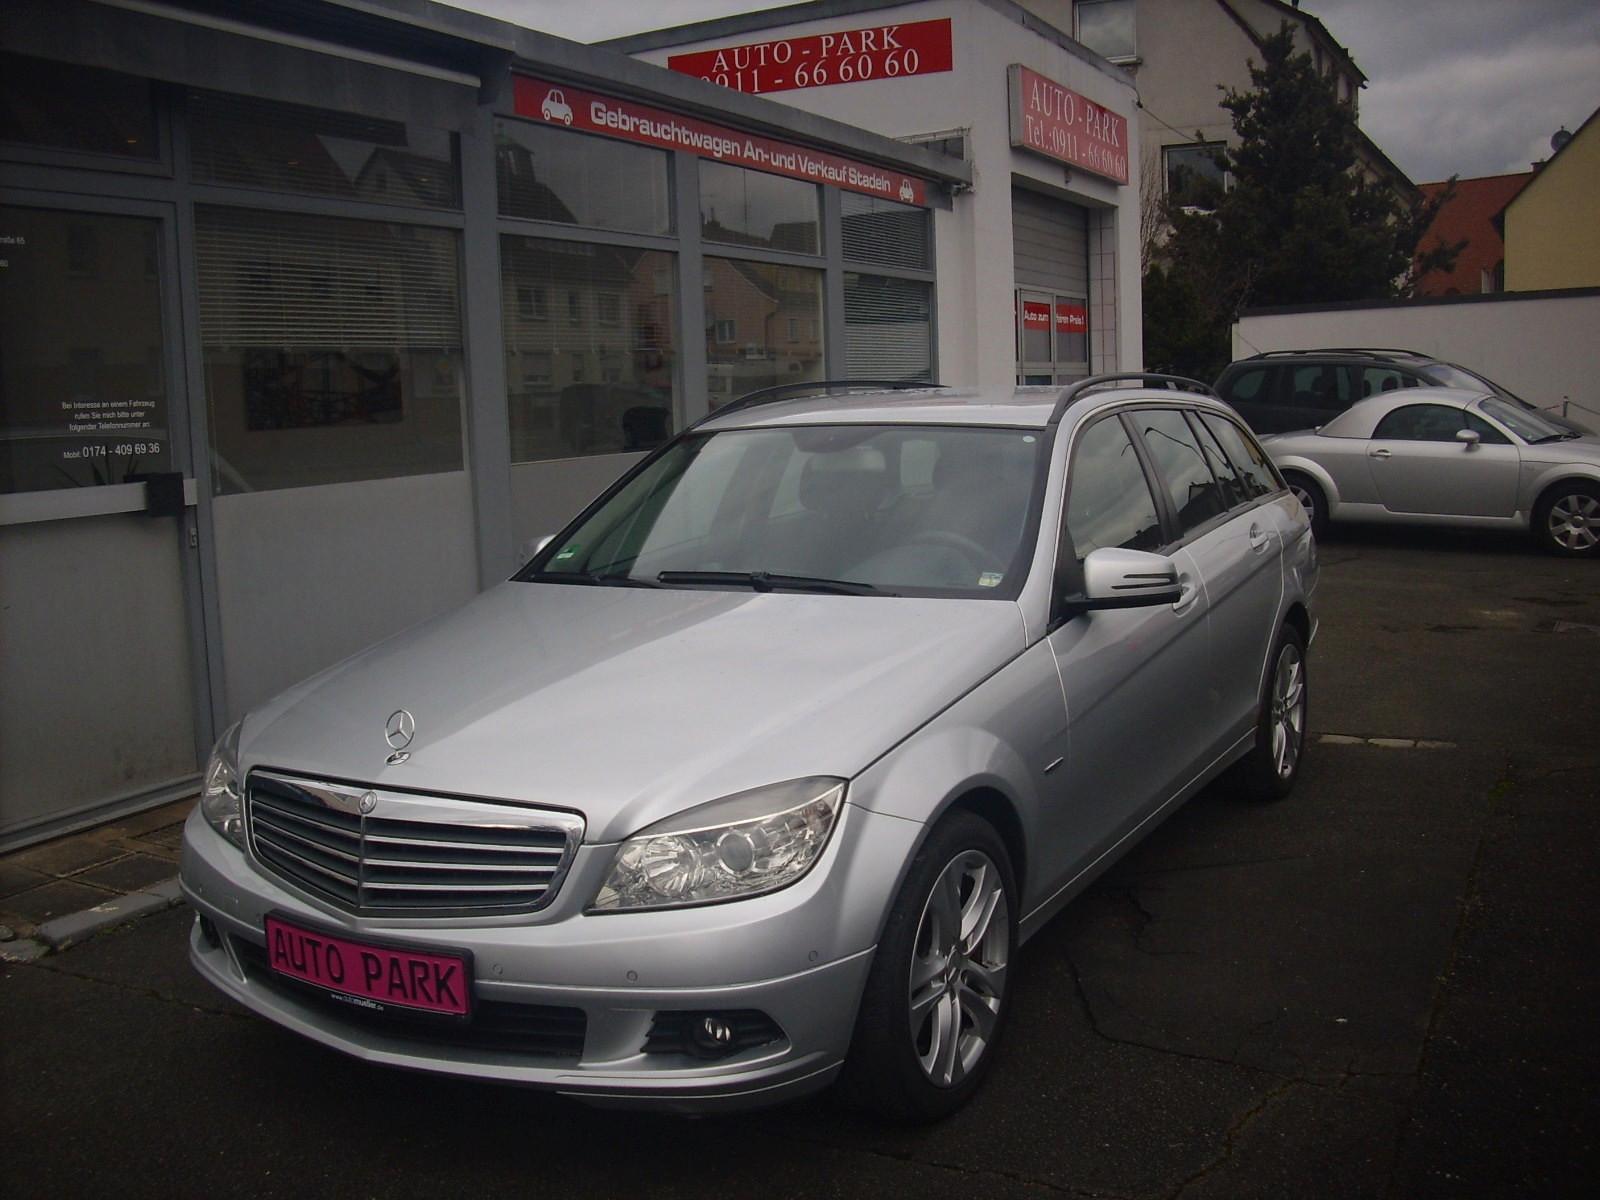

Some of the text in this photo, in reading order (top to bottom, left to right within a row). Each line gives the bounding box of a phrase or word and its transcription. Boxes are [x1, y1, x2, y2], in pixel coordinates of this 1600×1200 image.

[712, 41, 792, 73] AUTO
[820, 26, 903, 58] PARK
[794, 58, 828, 88] 66
[838, 55, 873, 82] 60
[884, 49, 919, 77] 60
[1031, 79, 1075, 126] AUTO
[1086, 103, 1120, 148] PARK
[590, 101, 741, 158] Gebrauchtwagen
[797, 155, 847, 182] Verkauf
[847, 167, 891, 193] Stadeln
[1088, 142, 1101, 168] 66
[1102, 148, 1113, 175] 60
[1115, 153, 1126, 178] 60
[73, 401, 101, 409] Interesse
[102, 401, 110, 409] an
[110, 400, 128, 408] einem
[128, 399, 156, 409] Fahrzeug
[91, 411, 101, 420] Sie
[102, 411, 116, 419] mich
[117, 410, 130, 418] bitte
[130, 410, 145, 418] unter
[69, 422, 97, 432] folgender
[98, 421, 141, 430] Telefonnummer
[82, 445, 107, 458] 0174
[115, 443, 133, 456] 409
[134, 443, 147, 455] 69
[148, 442, 160, 454] 36
[275, 927, 459, 1007] AUTO PARK
